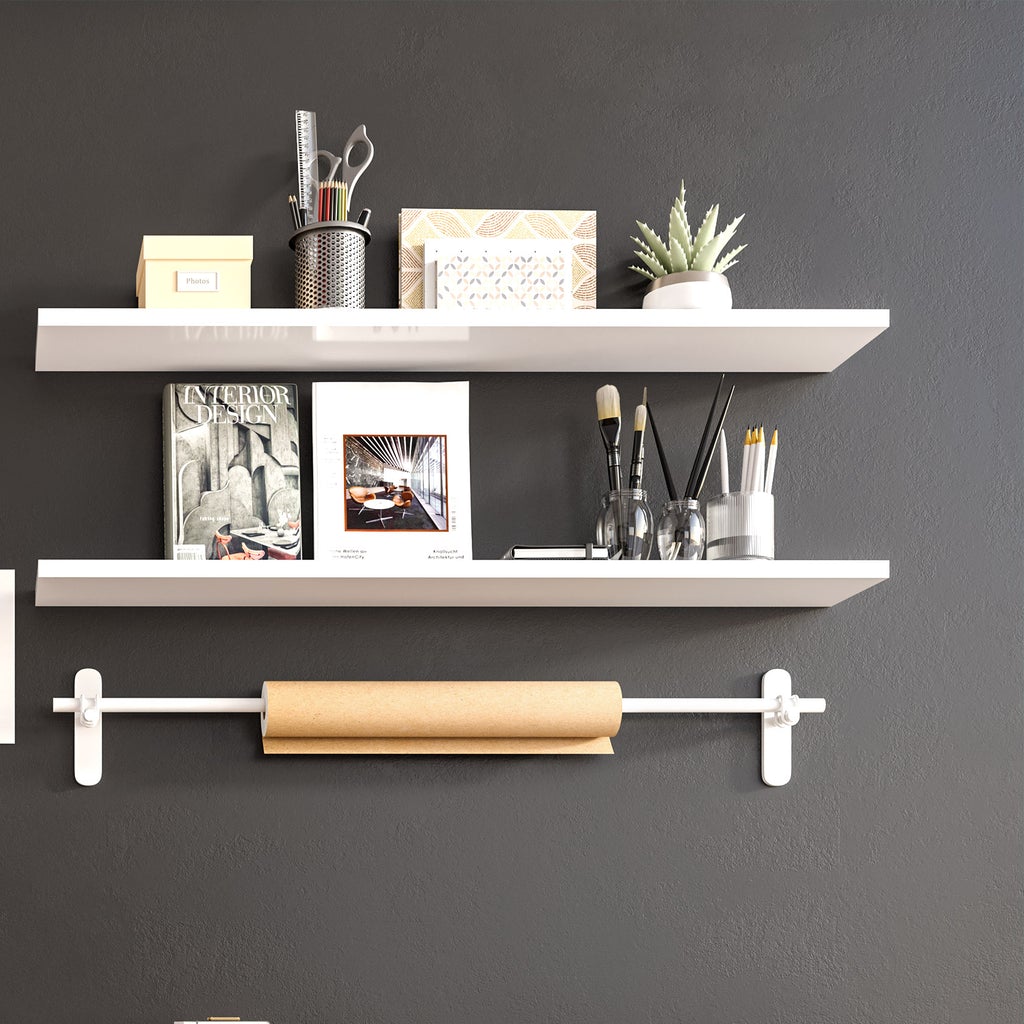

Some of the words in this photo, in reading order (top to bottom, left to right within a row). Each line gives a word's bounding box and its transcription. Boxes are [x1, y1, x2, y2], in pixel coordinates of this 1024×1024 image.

[186, 277, 210, 285] Photos
[183, 385, 291, 405] INTERIOR
[195, 404, 279, 424] DESIGN
